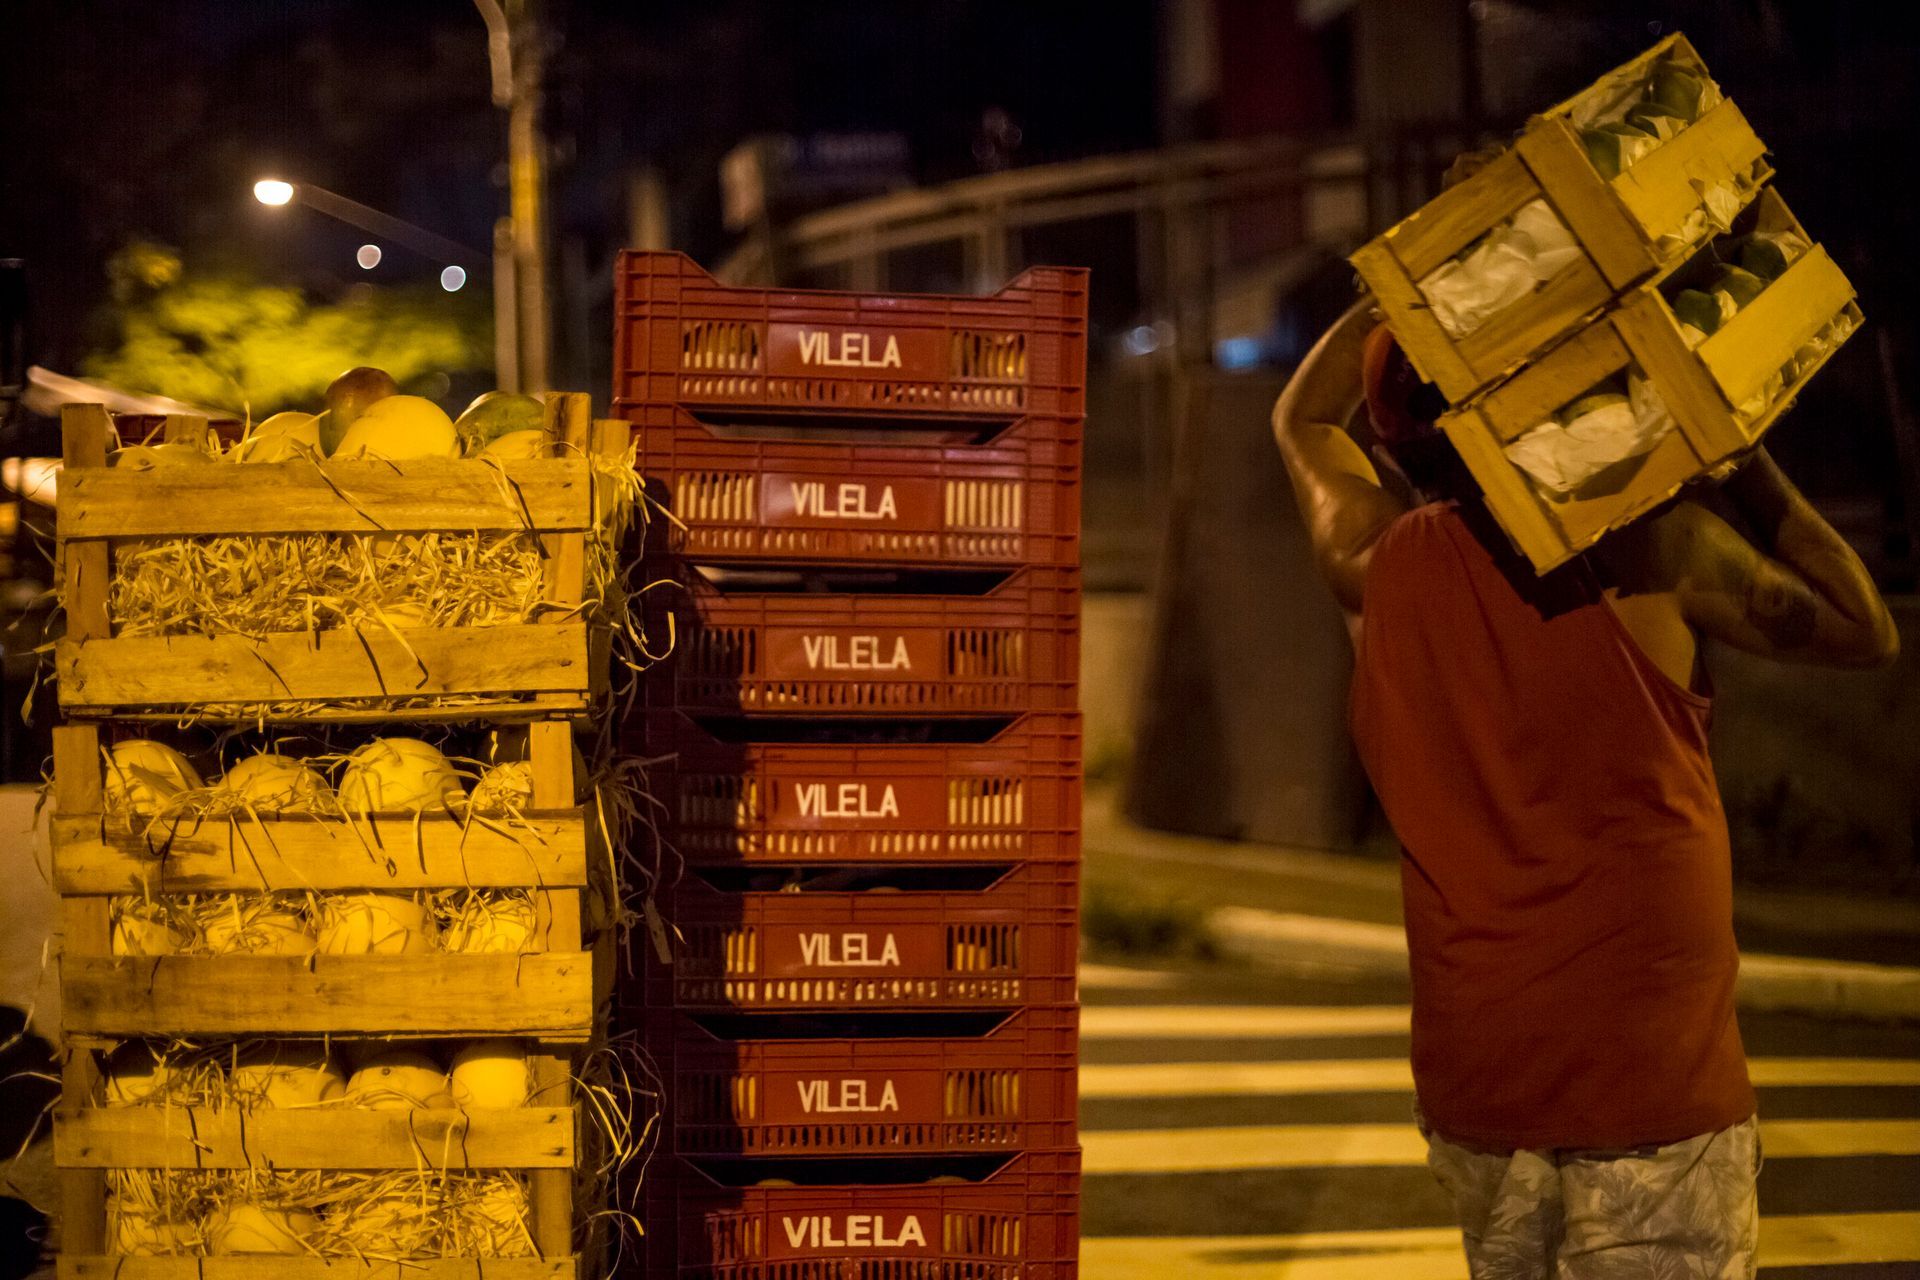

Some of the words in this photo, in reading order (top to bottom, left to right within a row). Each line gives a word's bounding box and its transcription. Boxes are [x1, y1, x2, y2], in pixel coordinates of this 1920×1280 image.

[798, 330, 902, 368] VILELA
[791, 482, 898, 520] VILELA
[803, 635, 911, 670] VILELA
[795, 783, 899, 818] VILELA
[798, 933, 900, 967] VILELA
[797, 1080, 899, 1113] VILELA
[782, 1215, 927, 1248] VILELA
